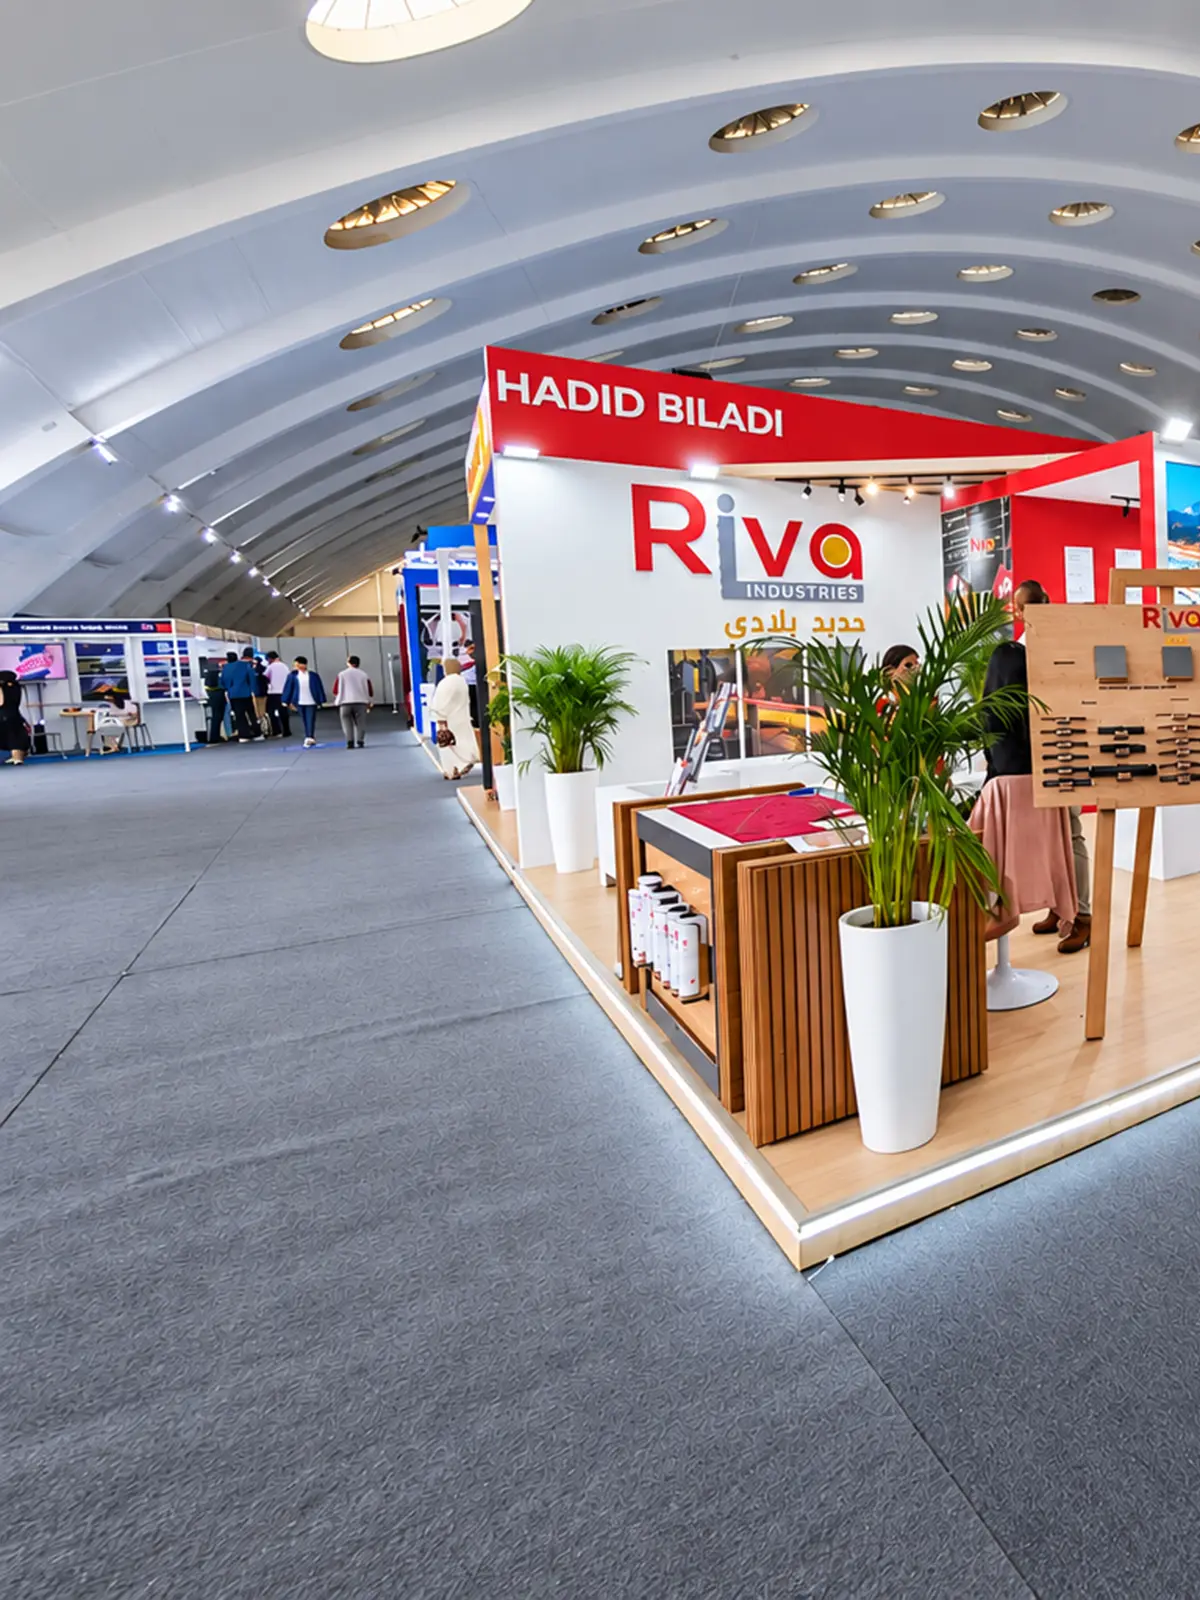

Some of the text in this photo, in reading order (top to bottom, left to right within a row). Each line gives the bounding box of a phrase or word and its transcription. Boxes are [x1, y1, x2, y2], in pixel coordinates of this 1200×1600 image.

[496, 369, 784, 438] HADID BILADI
[746, 584, 858, 600] INDUSTRIES
